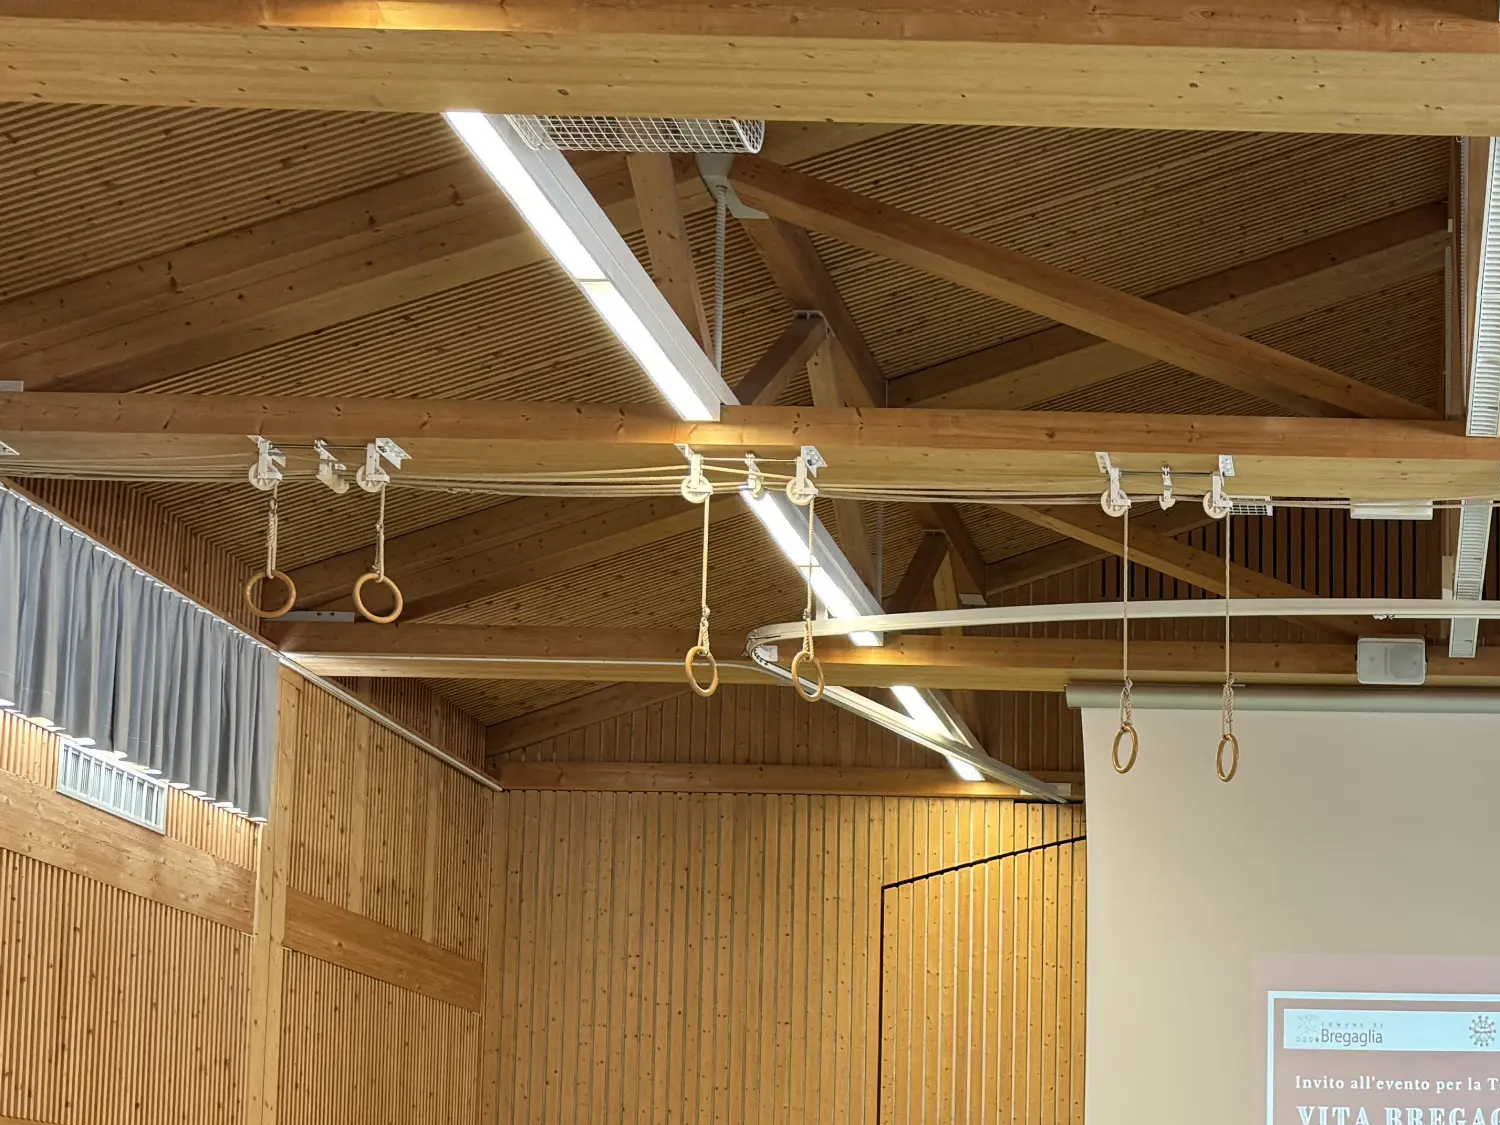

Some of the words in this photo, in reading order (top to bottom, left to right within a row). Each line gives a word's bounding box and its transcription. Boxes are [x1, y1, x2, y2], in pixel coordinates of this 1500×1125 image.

[1321, 1028, 1383, 1047] Bregaglia
[1295, 1075, 1345, 1090] Invito
[1350, 1076, 1430, 1091] all'evento
[1436, 1078, 1463, 1094] per
[1467, 1077, 1482, 1091] la
